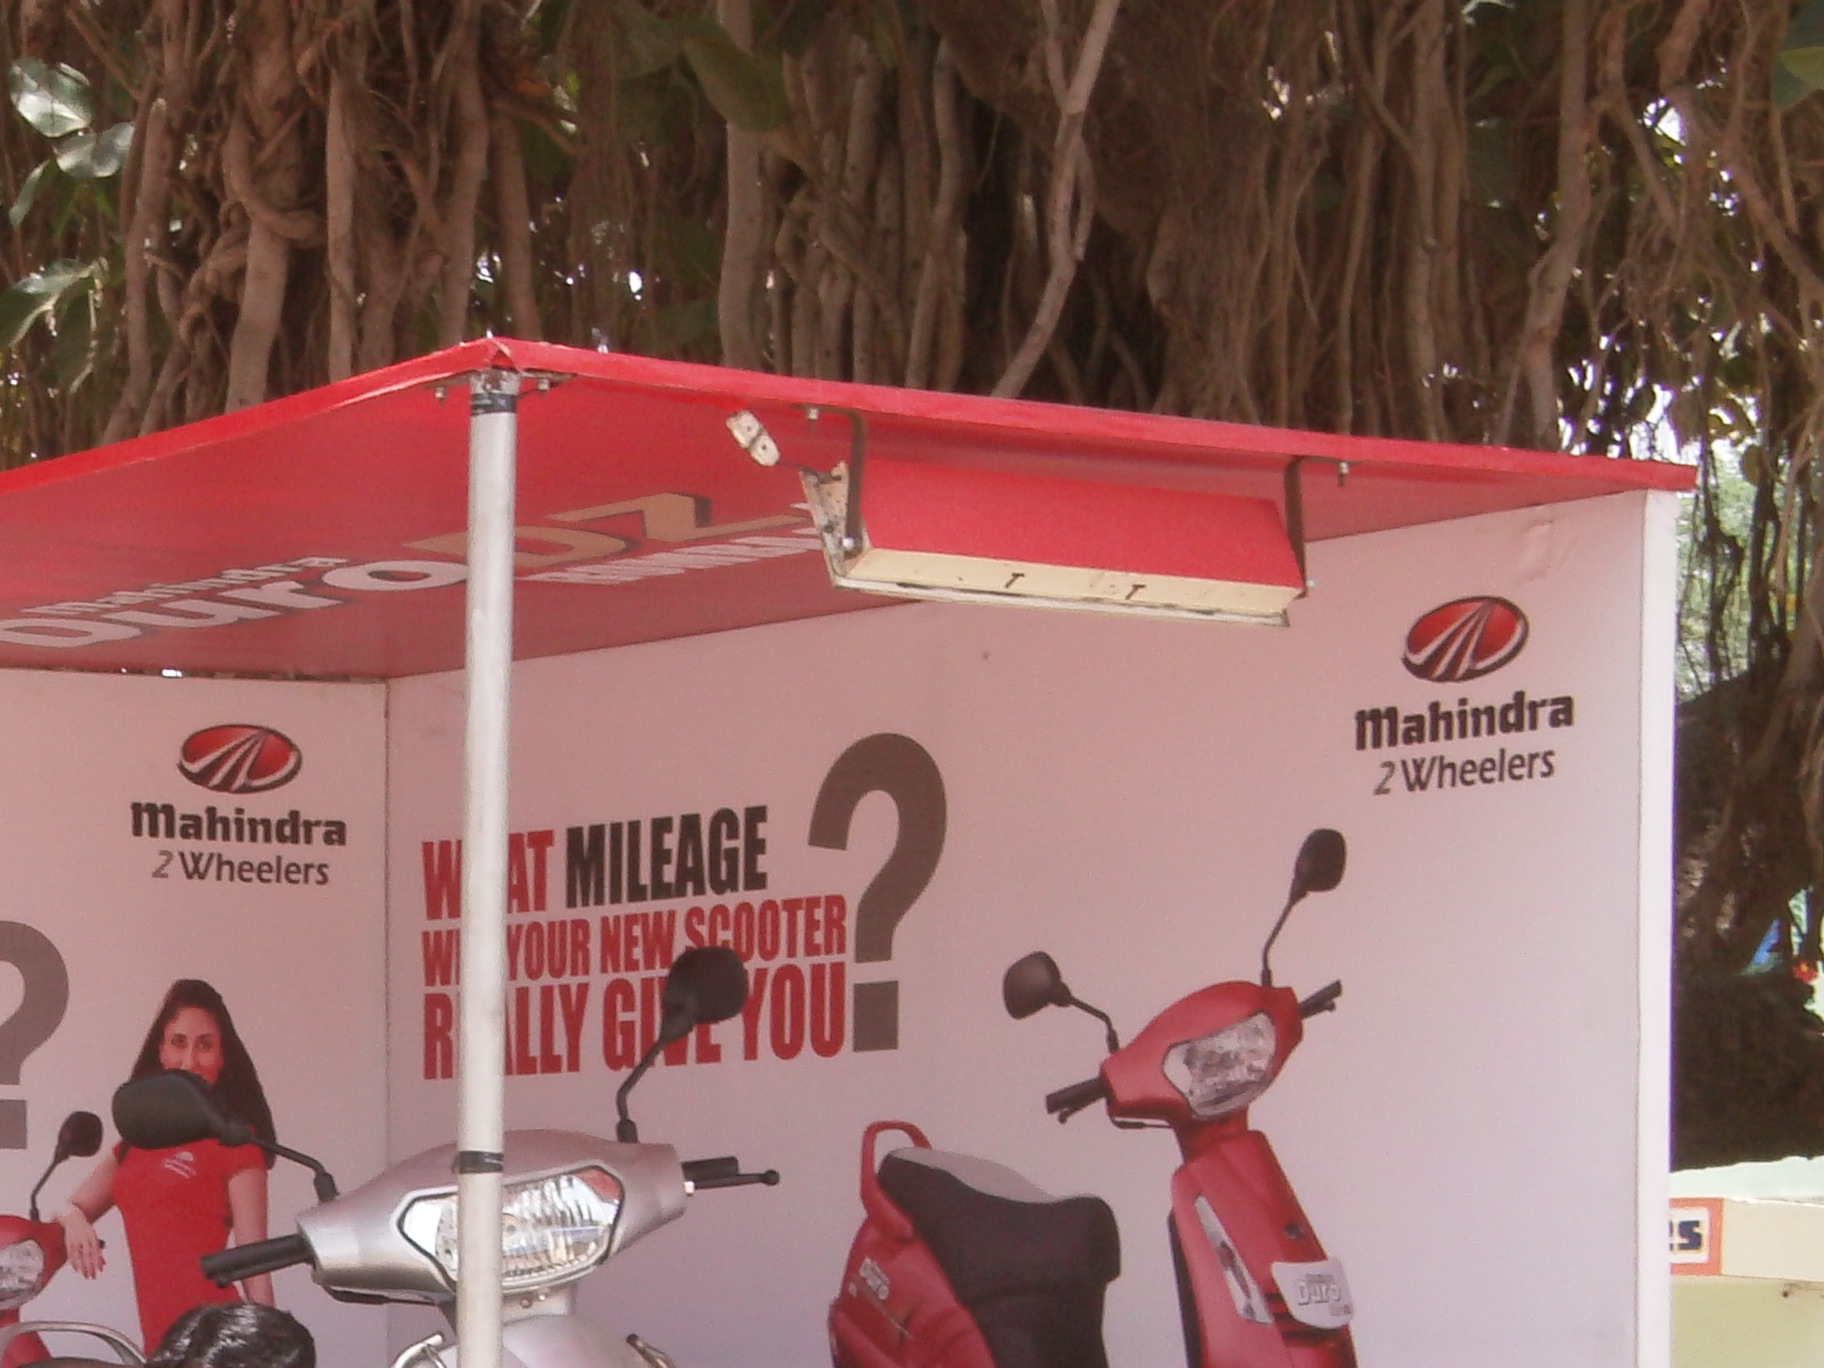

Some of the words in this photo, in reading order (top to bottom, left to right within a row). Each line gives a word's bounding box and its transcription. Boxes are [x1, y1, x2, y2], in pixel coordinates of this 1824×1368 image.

[1401, 748, 1555, 792] Wheelers
[179, 851, 329, 885] Wheelers
[422, 829, 554, 920] WAT
[566, 806, 768, 909] MILEAGE
[600, 909, 677, 973] NEW
[684, 894, 847, 964] SCOOTER
[742, 962, 846, 1060] YOU
